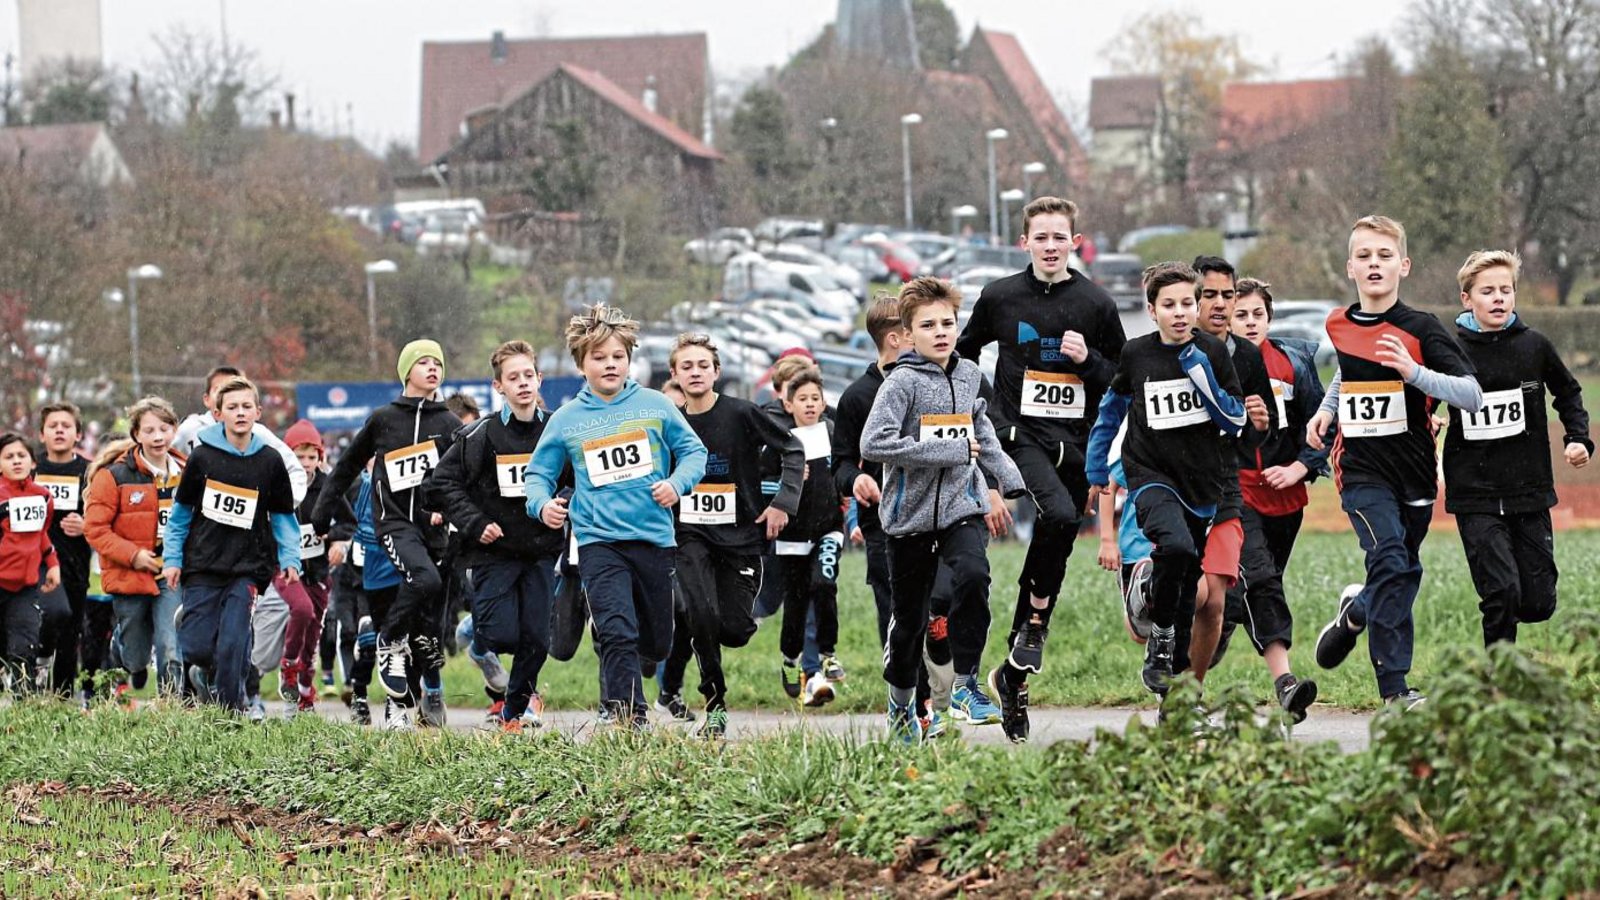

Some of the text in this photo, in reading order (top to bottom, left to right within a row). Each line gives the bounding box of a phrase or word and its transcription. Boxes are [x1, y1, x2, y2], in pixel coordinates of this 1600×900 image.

[1033, 384, 1075, 405] 209
[1150, 388, 1204, 415] 1180
[1346, 396, 1391, 420] 137
[1467, 401, 1522, 426] 1178
[395, 454, 430, 477] 773
[598, 444, 640, 470] 103
[44, 484, 70, 499] 35
[690, 493, 726, 512] 190
[14, 506, 45, 521] 1256
[213, 493, 247, 515] 195
